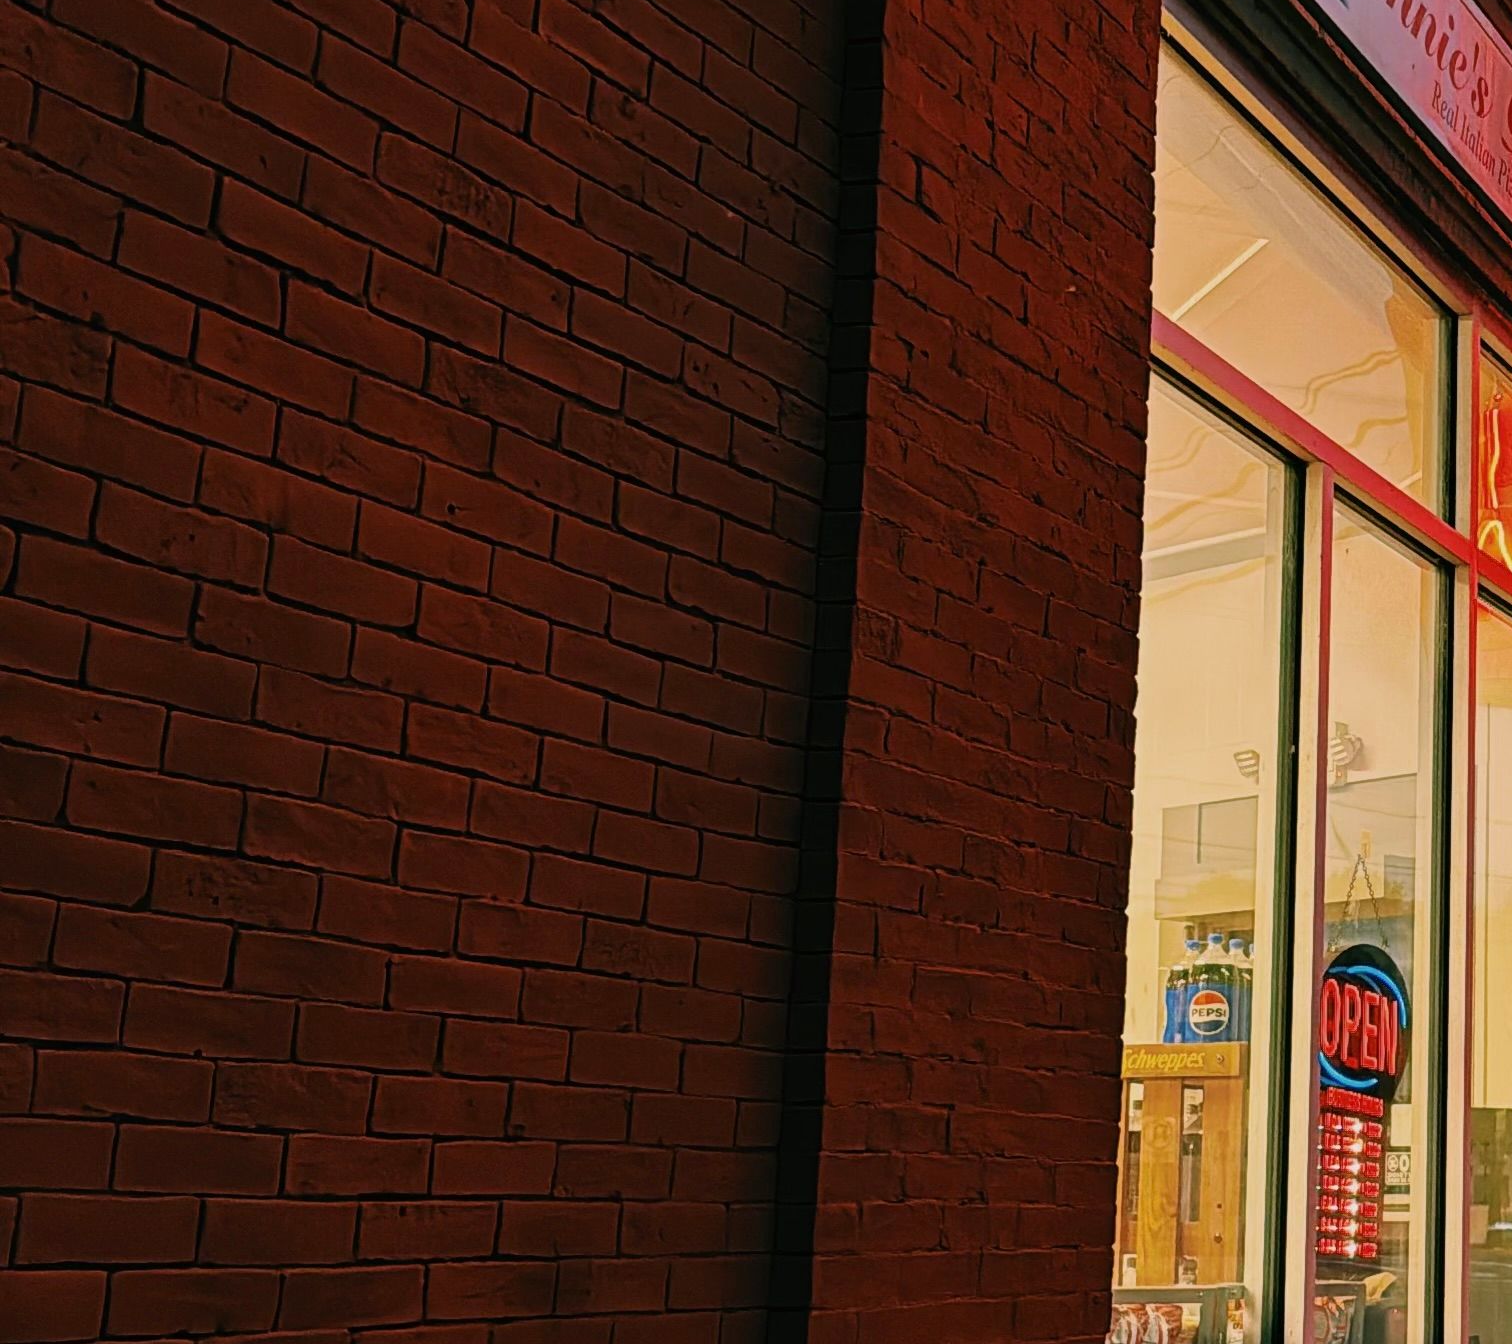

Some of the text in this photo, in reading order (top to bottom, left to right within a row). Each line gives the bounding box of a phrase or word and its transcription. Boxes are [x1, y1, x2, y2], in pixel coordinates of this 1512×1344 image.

[1431, 80, 1460, 132] Real
[1460, 114, 1496, 176] Italian
[1191, 1007, 1227, 1018] PEPSI
[1319, 978, 1398, 1076] OPEN
[1124, 1049, 1206, 1072] Schweppes
